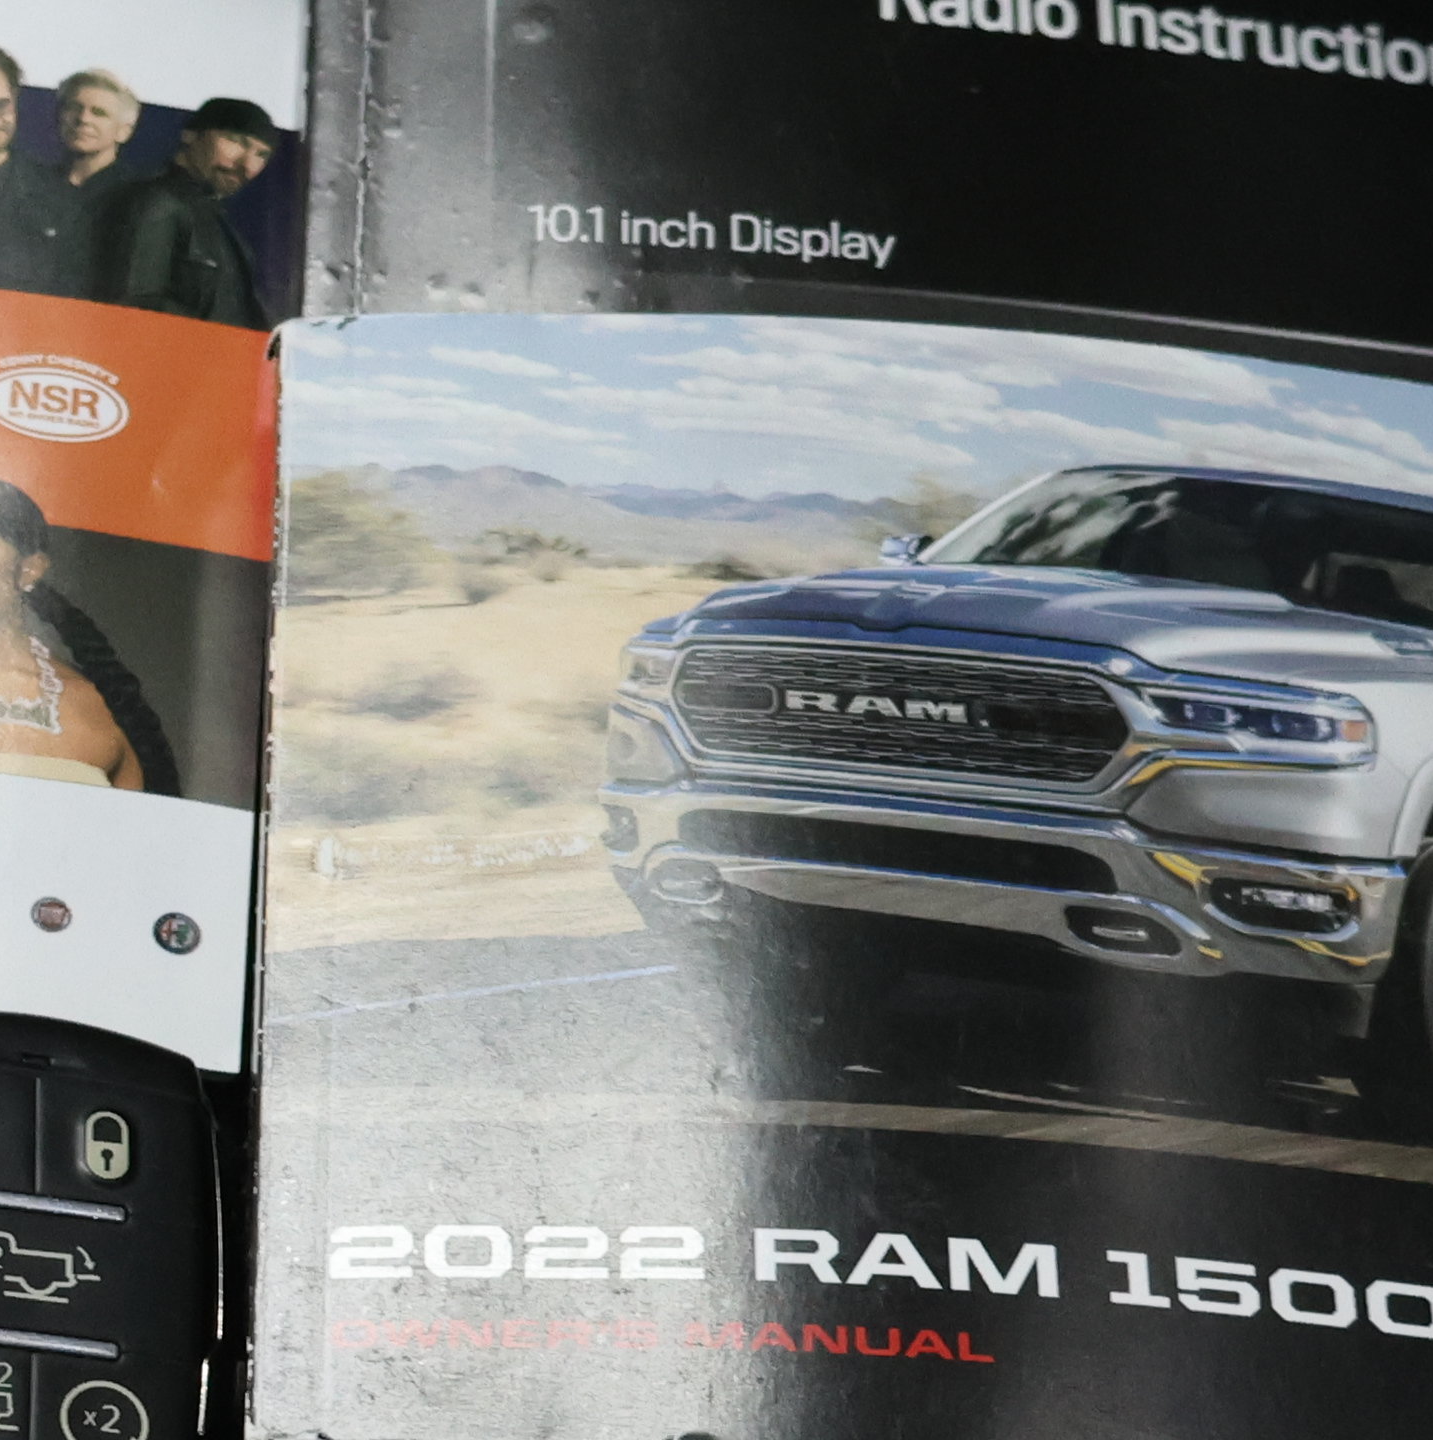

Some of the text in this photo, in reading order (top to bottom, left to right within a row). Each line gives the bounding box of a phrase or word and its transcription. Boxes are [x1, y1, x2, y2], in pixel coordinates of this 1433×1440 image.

[527, 204, 896, 269] 10.1 inch Display
[9, 380, 100, 419] NSR
[784, 687, 969, 724] RAM
[328, 1223, 706, 1281] 2022
[753, 1226, 1061, 1299] RAM
[332, 1317, 995, 1363] OWNER'S MANUAL
